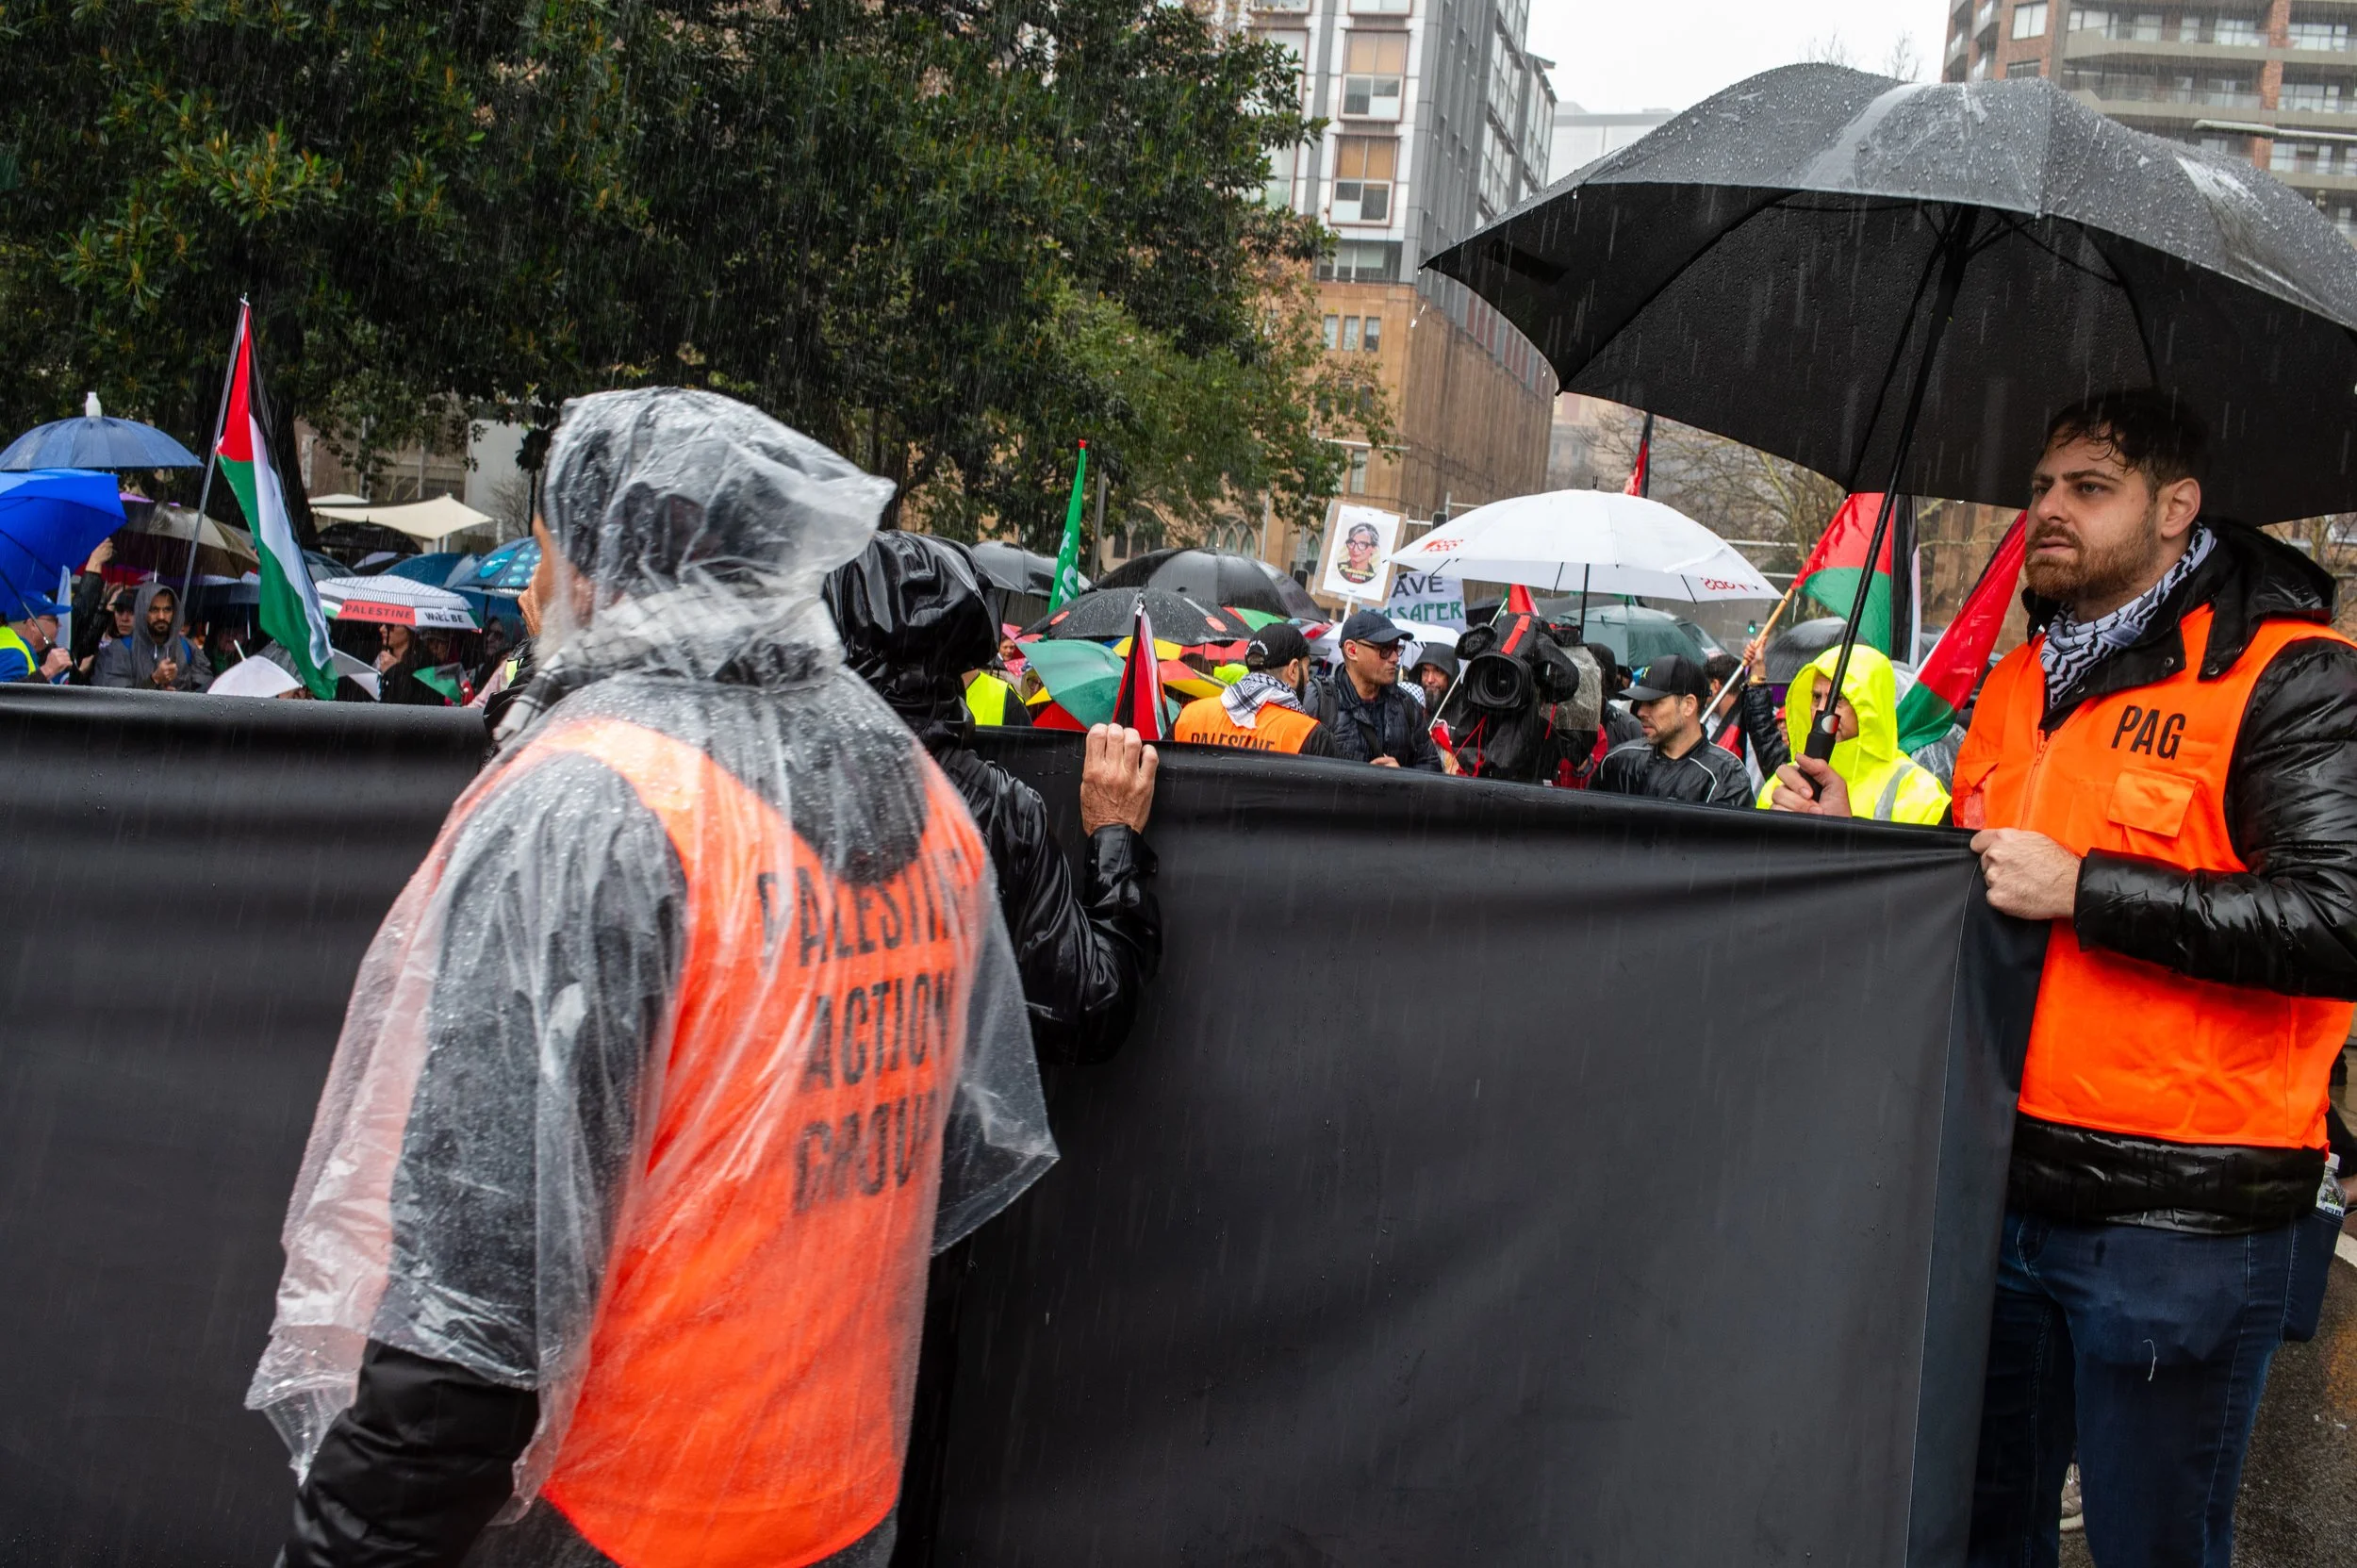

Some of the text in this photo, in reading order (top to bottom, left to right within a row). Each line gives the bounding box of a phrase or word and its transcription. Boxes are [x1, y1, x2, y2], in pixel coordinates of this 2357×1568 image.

[1391, 574, 1444, 598] AVE
[345, 604, 412, 620] PALESTINE
[452, 614, 465, 623] BE
[2111, 704, 2186, 761] PAG
[802, 967, 955, 1093] ACTION
